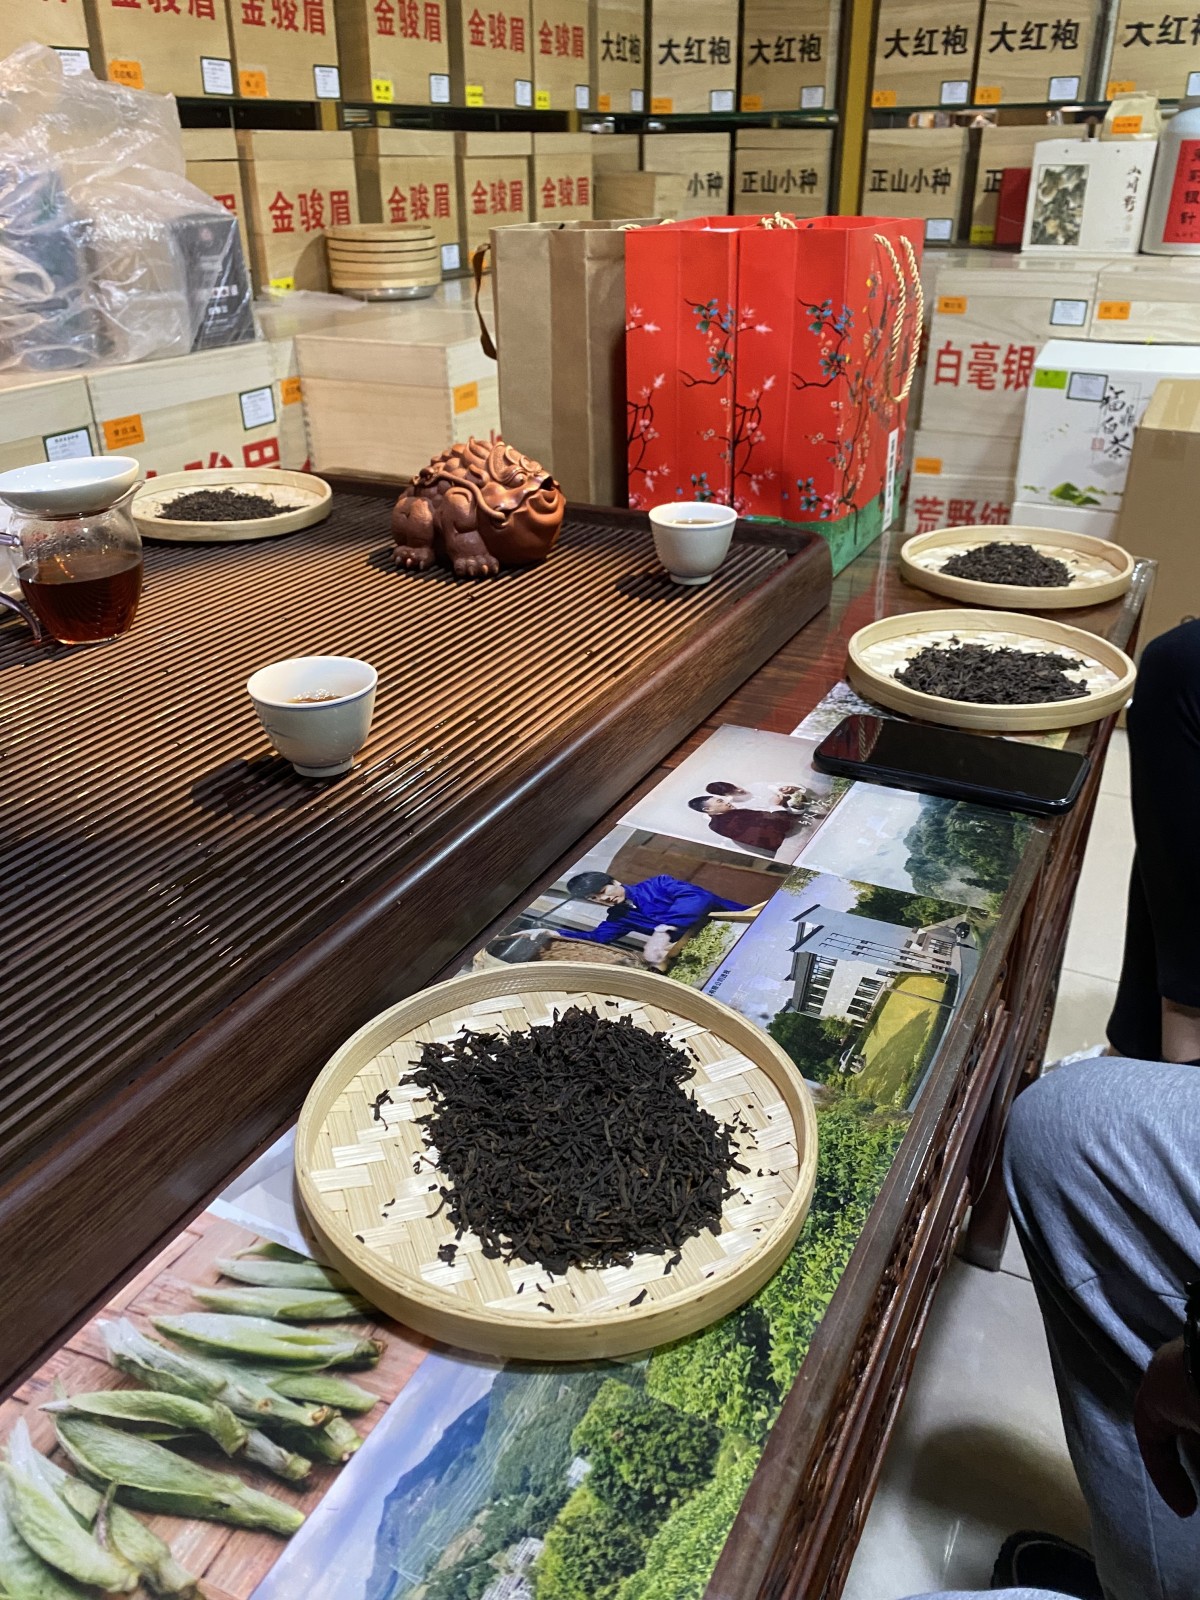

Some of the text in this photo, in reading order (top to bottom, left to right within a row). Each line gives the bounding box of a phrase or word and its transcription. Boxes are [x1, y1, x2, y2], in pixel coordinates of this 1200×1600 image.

[374, 0, 442, 43] 金骏眉
[468, 8, 525, 53] 金骏眉
[988, 18, 1080, 54] 大红袍
[538, 20, 585, 59] 金骏眉
[601, 31, 641, 64] 大红袍
[659, 36, 731, 65] 大红袍
[748, 33, 822, 66] 大红袍
[884, 24, 968, 59] 大红袍
[471, 179, 523, 215] 金骏眉
[541, 175, 589, 208] 金骏眉
[687, 172, 723, 198] 小种
[741, 167, 818, 194] 正山小种
[869, 168, 951, 195] 正山小种
[269, 188, 352, 234] 金骏眉
[388, 183, 450, 223] 金骏眉
[934, 340, 1036, 392] 白毫银
